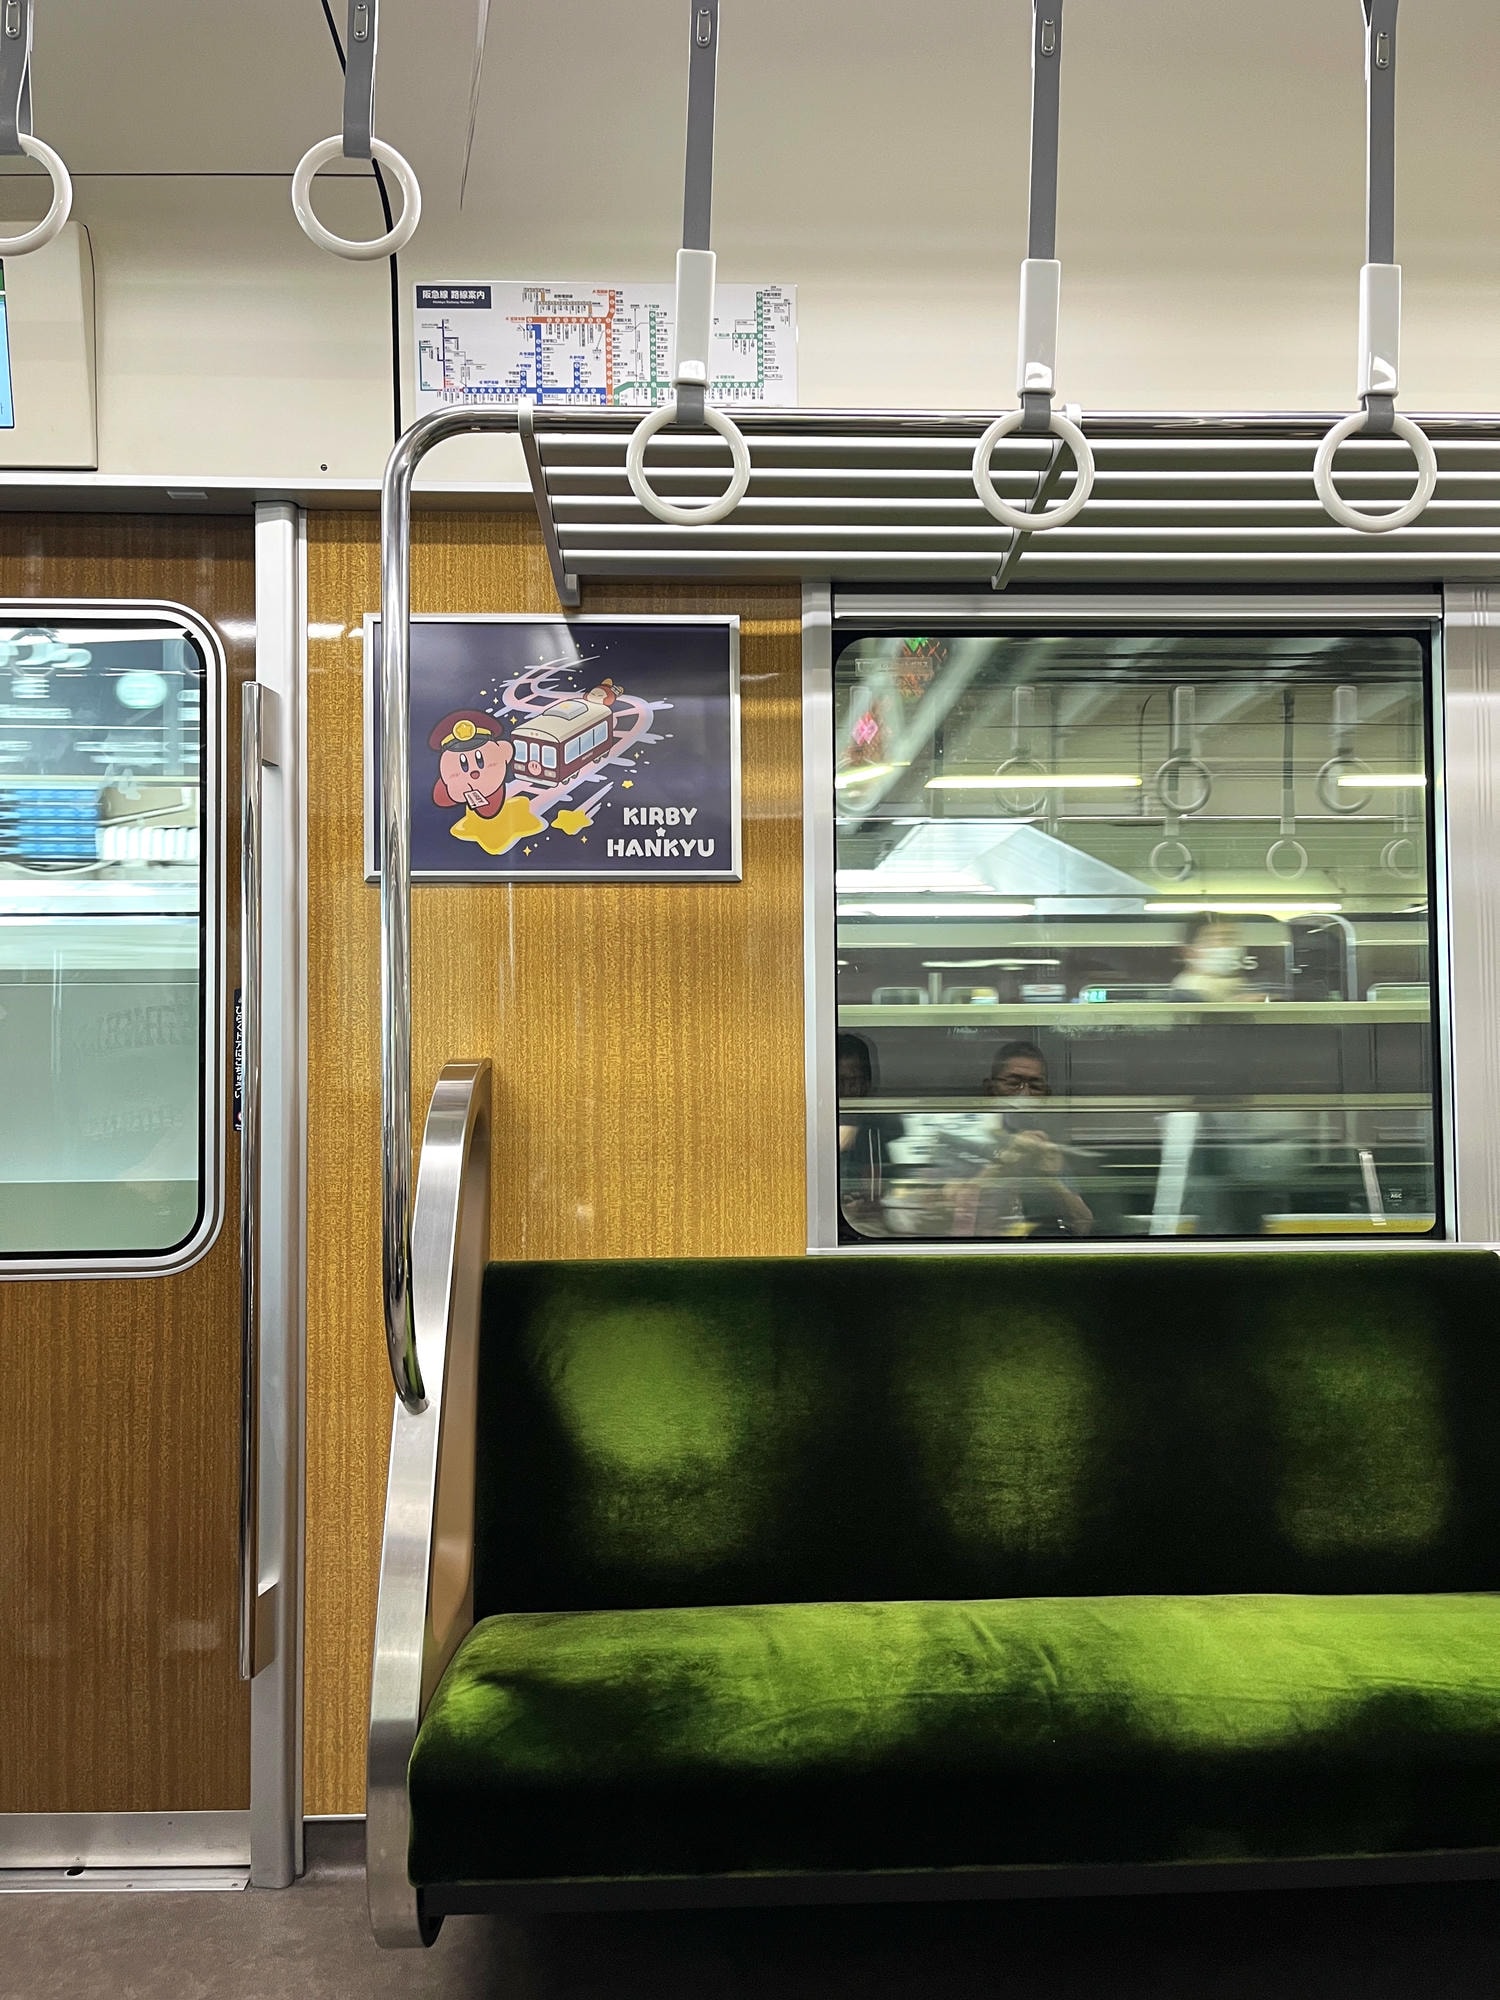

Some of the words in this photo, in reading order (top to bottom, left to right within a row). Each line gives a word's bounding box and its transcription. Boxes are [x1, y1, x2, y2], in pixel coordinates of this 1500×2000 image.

[422, 290, 448, 299] 阪急線
[451, 290, 485, 299] 路線案内
[623, 807, 697, 826] KIRBY
[607, 838, 715, 857] HANKYU
